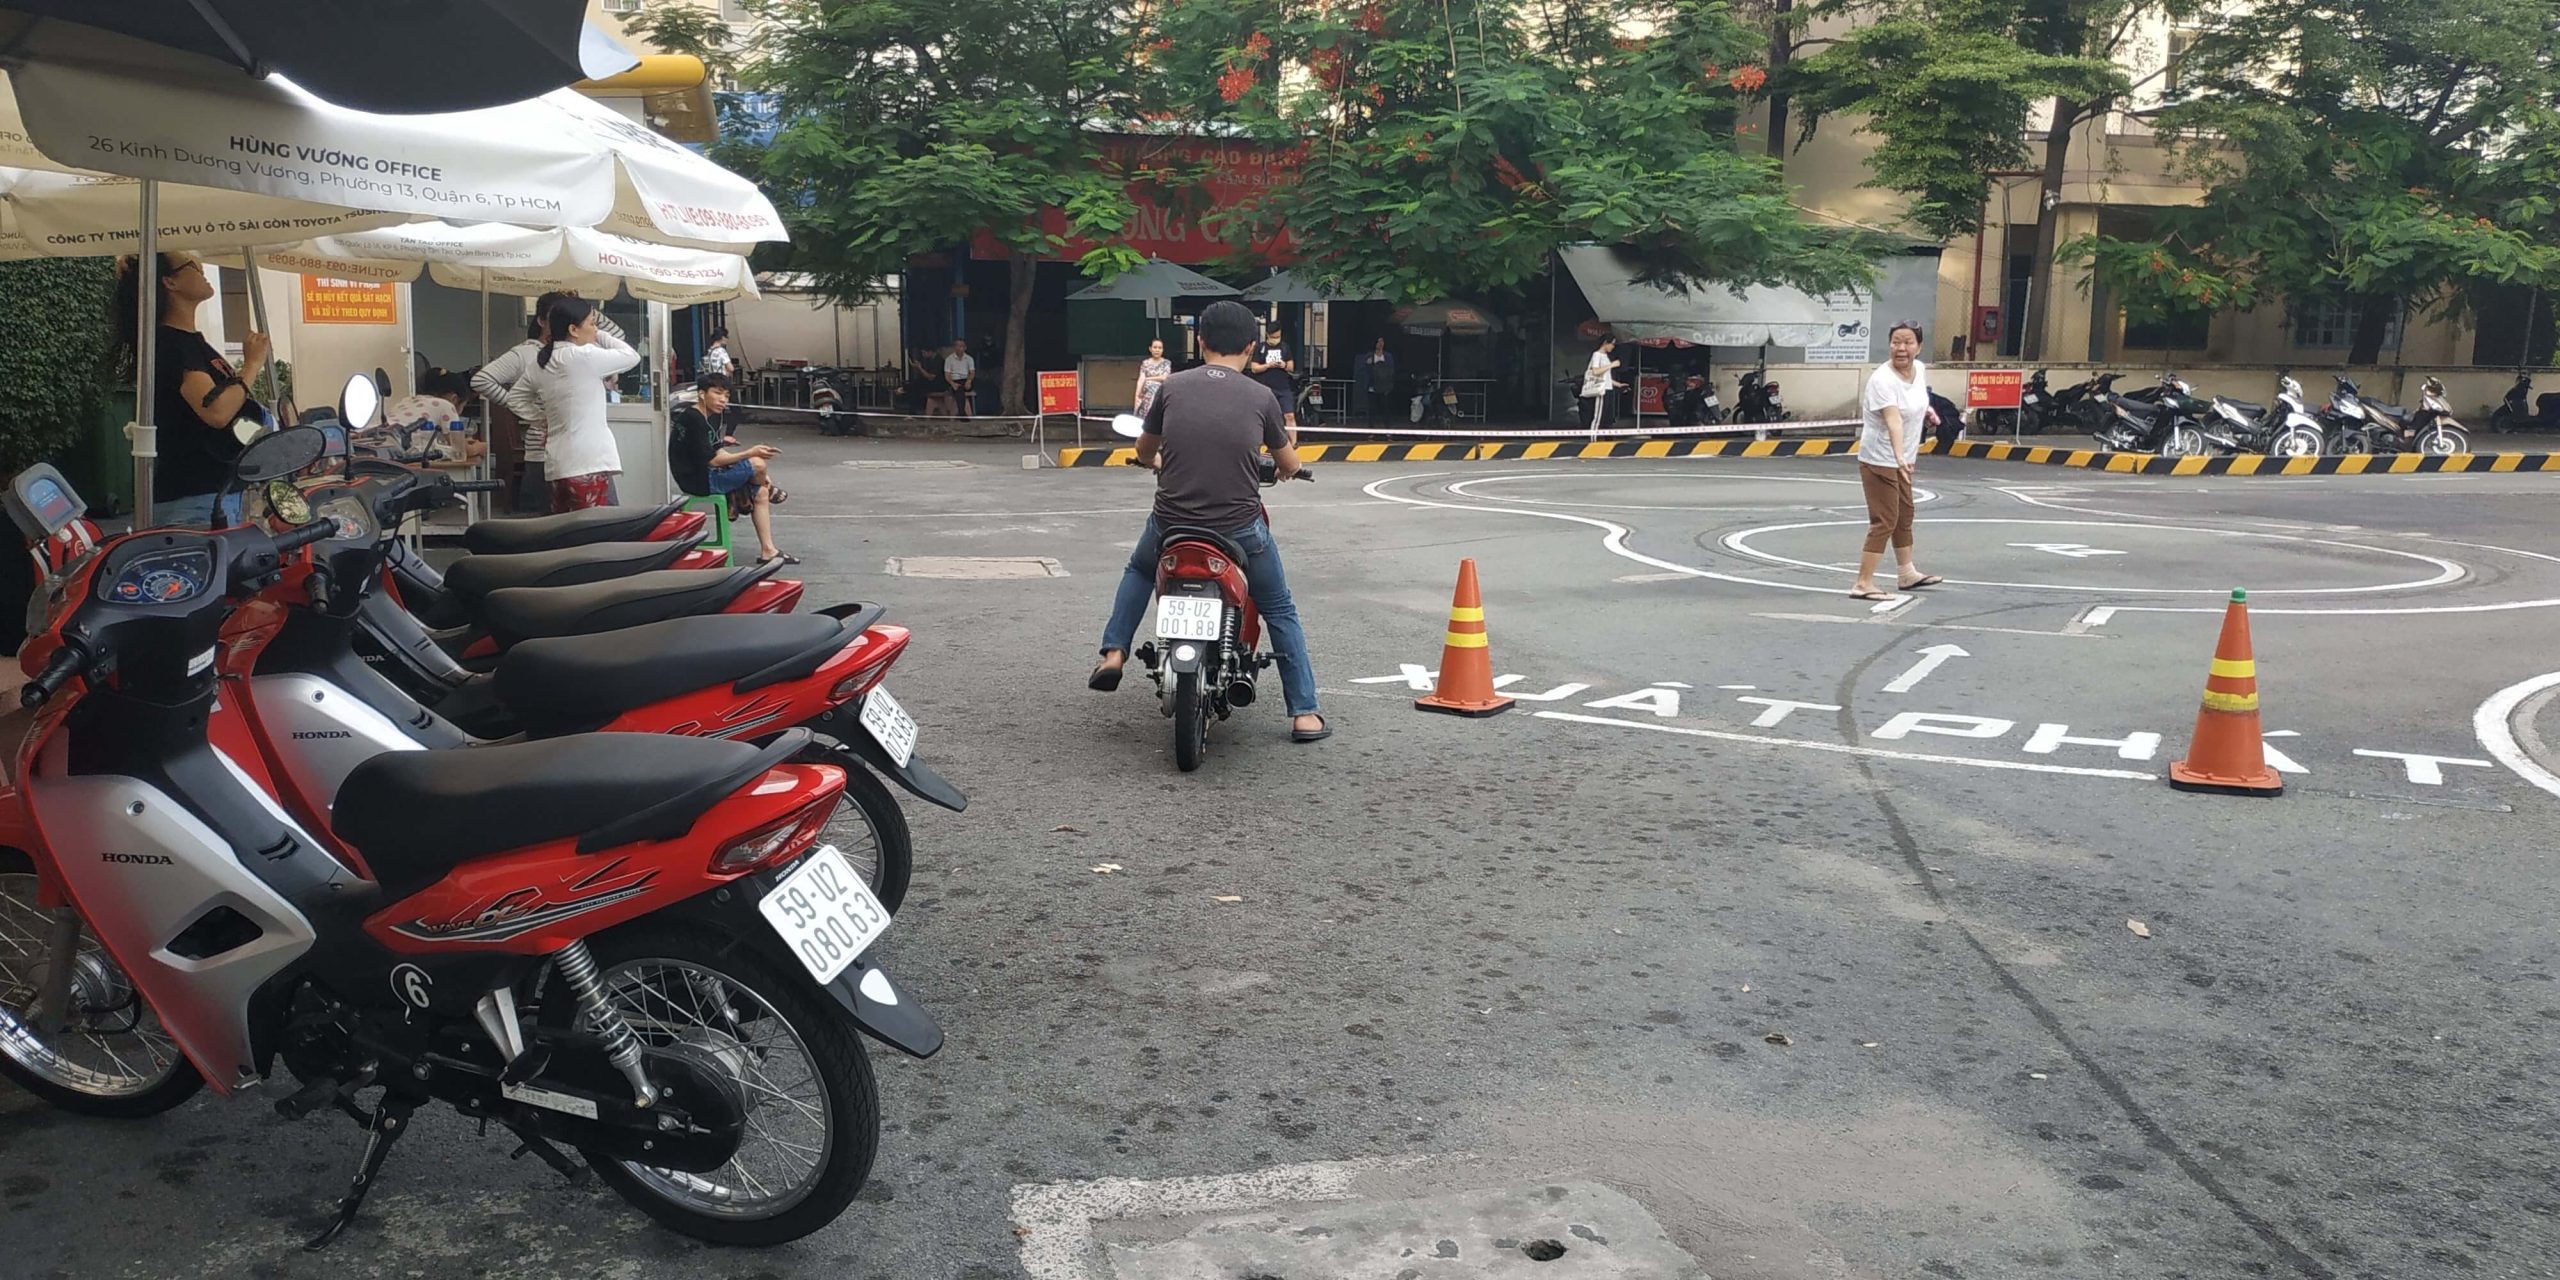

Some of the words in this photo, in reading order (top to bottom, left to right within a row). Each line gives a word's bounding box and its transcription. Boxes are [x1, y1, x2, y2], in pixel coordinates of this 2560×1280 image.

[229, 134, 290, 160] HÙNG
[296, 145, 370, 171] VƯƠNG
[374, 158, 442, 182] OFFICE
[88, 135, 114, 153] 26
[119, 140, 168, 160] Kinh
[174, 147, 241, 175] Dương
[246, 160, 315, 186] Vương,
[320, 171, 393, 198] Phường
[396, 182, 418, 200] 13,
[422, 187, 471, 207] Quận
[475, 193, 491, 207] 6,
[495, 195, 516, 210] Tp
[520, 197, 562, 212] HCM
[46, 233, 86, 245] CÔNG
[88, 232, 105, 242] TY
[183, 223, 201, 236] VỤ
[205, 220, 215, 233] Ô
[218, 219, 236, 232] TÔ
[239, 217, 260, 231] SÀI
[263, 217, 290, 230] GÒN
[293, 215, 341, 228] TOYOTA
[435, 240, 464, 248] OFFICE
[331, 279, 348, 288] SINH
[1168, 600, 1211, 618] 59-U2
[1160, 617, 1215, 637] 001.88
[292, 730, 353, 740] HONDA
[101, 852, 175, 866] HONDA
[775, 859, 801, 883] HONDA
[775, 861, 848, 929] 59-U2
[800, 891, 881, 974] 080.63
[404, 970, 430, 1008] 6
